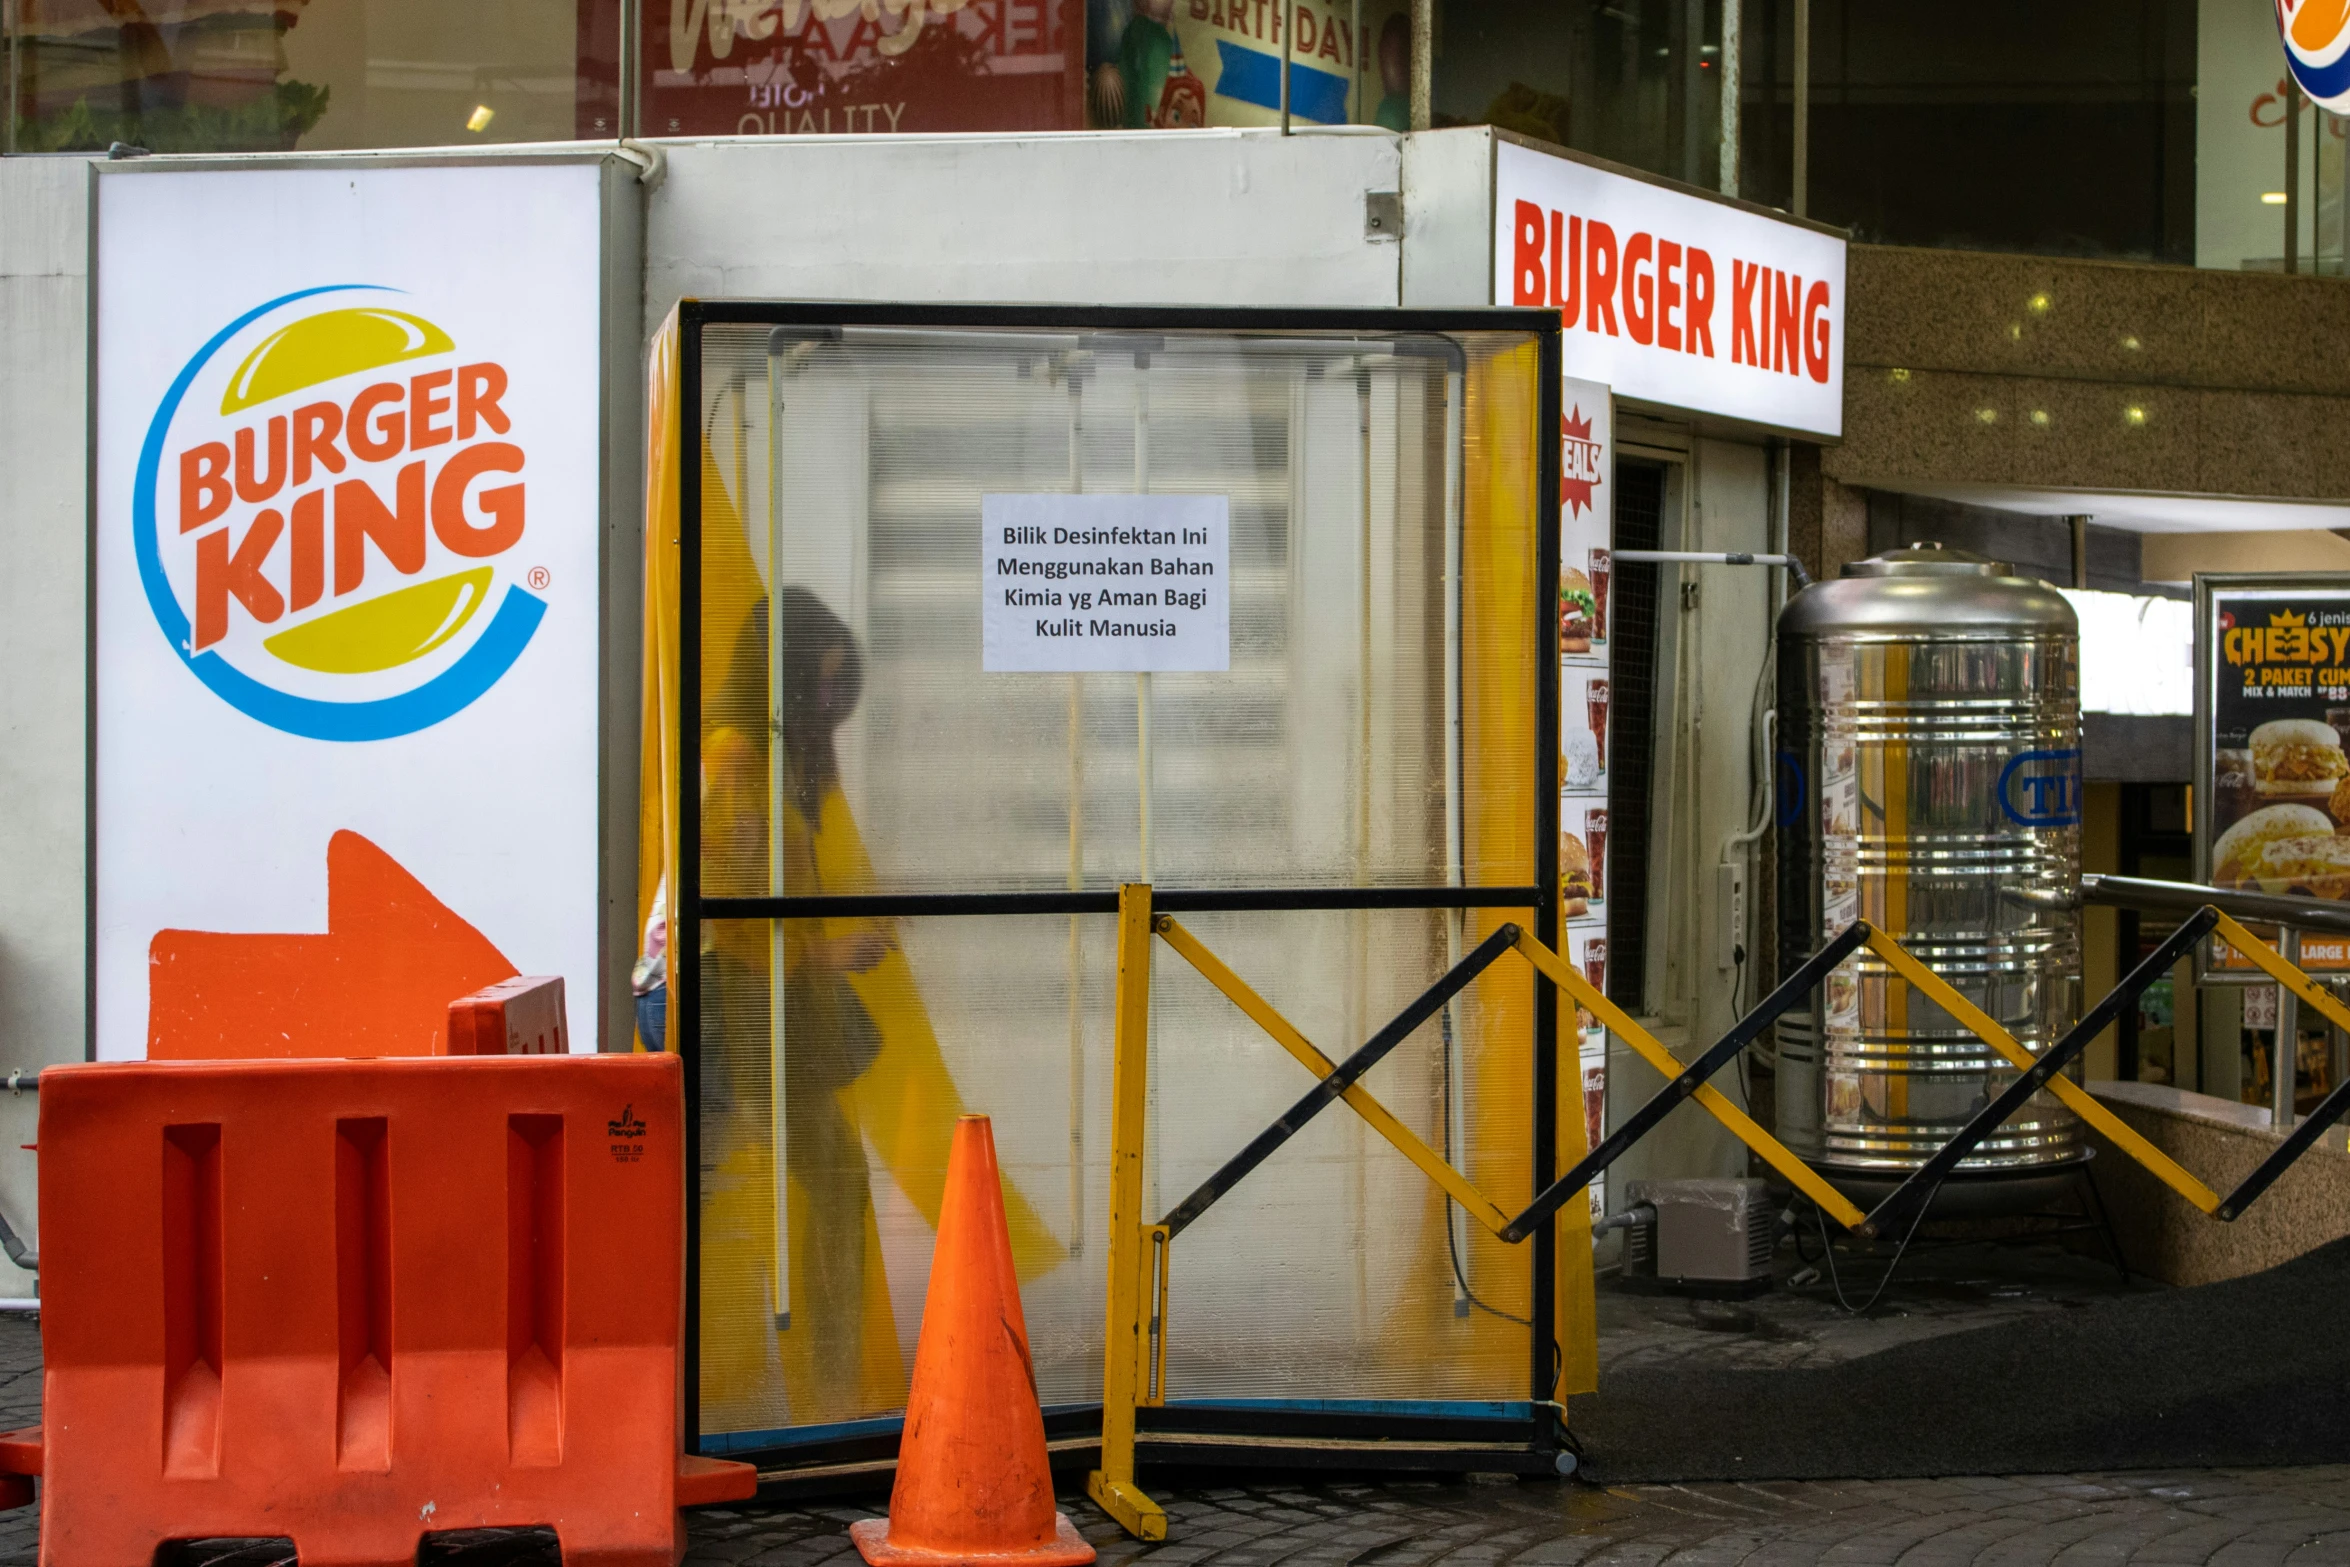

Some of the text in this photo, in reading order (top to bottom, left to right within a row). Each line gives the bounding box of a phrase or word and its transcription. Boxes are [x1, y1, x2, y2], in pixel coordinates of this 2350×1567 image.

[1513, 198, 1830, 384] BURGER KING
[180, 362, 511, 535] BURGER
[1003, 526, 1207, 545] Bilik Desinfektan Ini
[196, 442, 525, 651] KING
[997, 557, 1214, 580] Menggunakan Bahan
[1005, 588, 1207, 611] Kimia yg Aman Bagi
[1036, 618, 1176, 637] Kulit Manusia
[2307, 611, 2317, 625] 6
[2224, 627, 2350, 667] CHEESY
[2244, 668, 2256, 686] 2
[2261, 668, 2313, 686] PAKET
[2243, 686, 2263, 698] MIX
[2266, 686, 2275, 698] &
[2277, 686, 2312, 698] MATCH
[2301, 945, 2343, 959] LARGE
